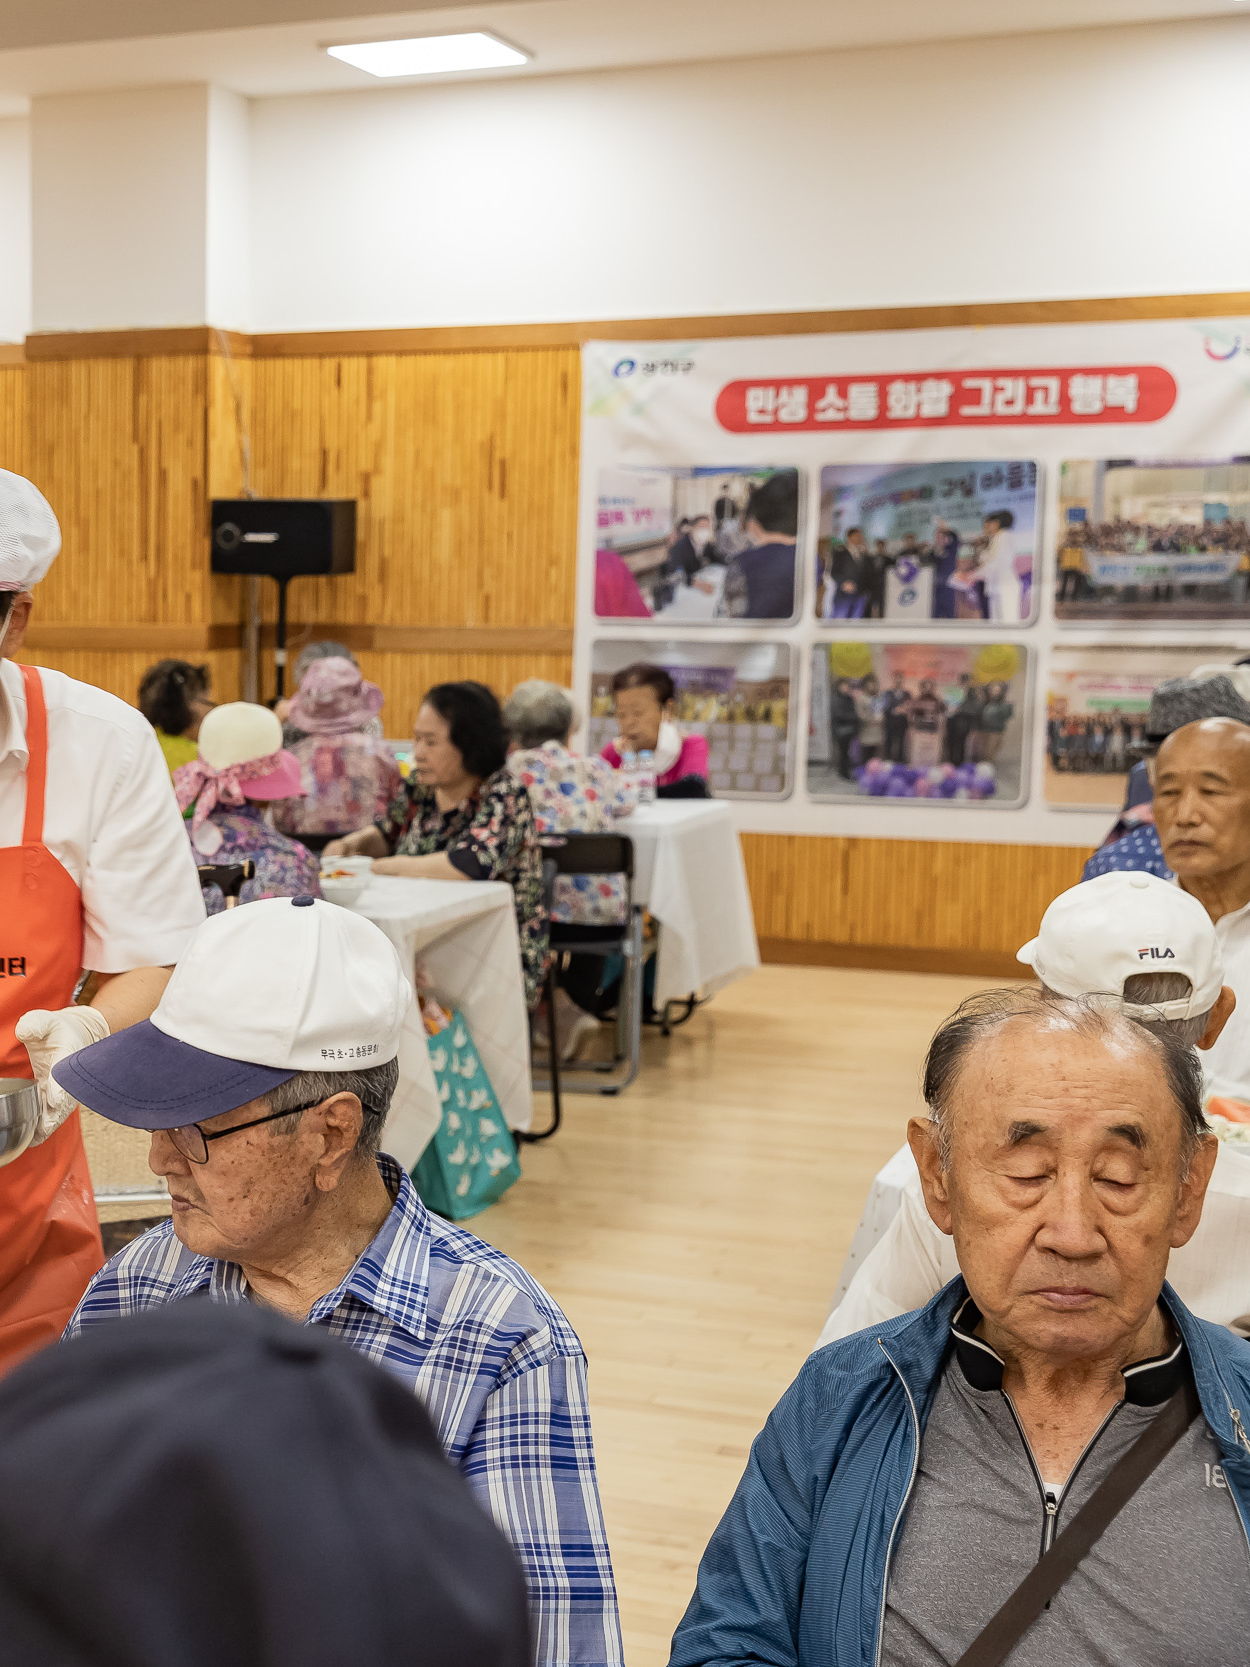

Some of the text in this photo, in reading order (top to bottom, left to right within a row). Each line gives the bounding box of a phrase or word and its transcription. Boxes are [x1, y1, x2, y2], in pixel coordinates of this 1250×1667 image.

[746, 373, 1139, 424] 민생 소통 화합 그리고 행복
[1138, 947, 1175, 960] FILA
